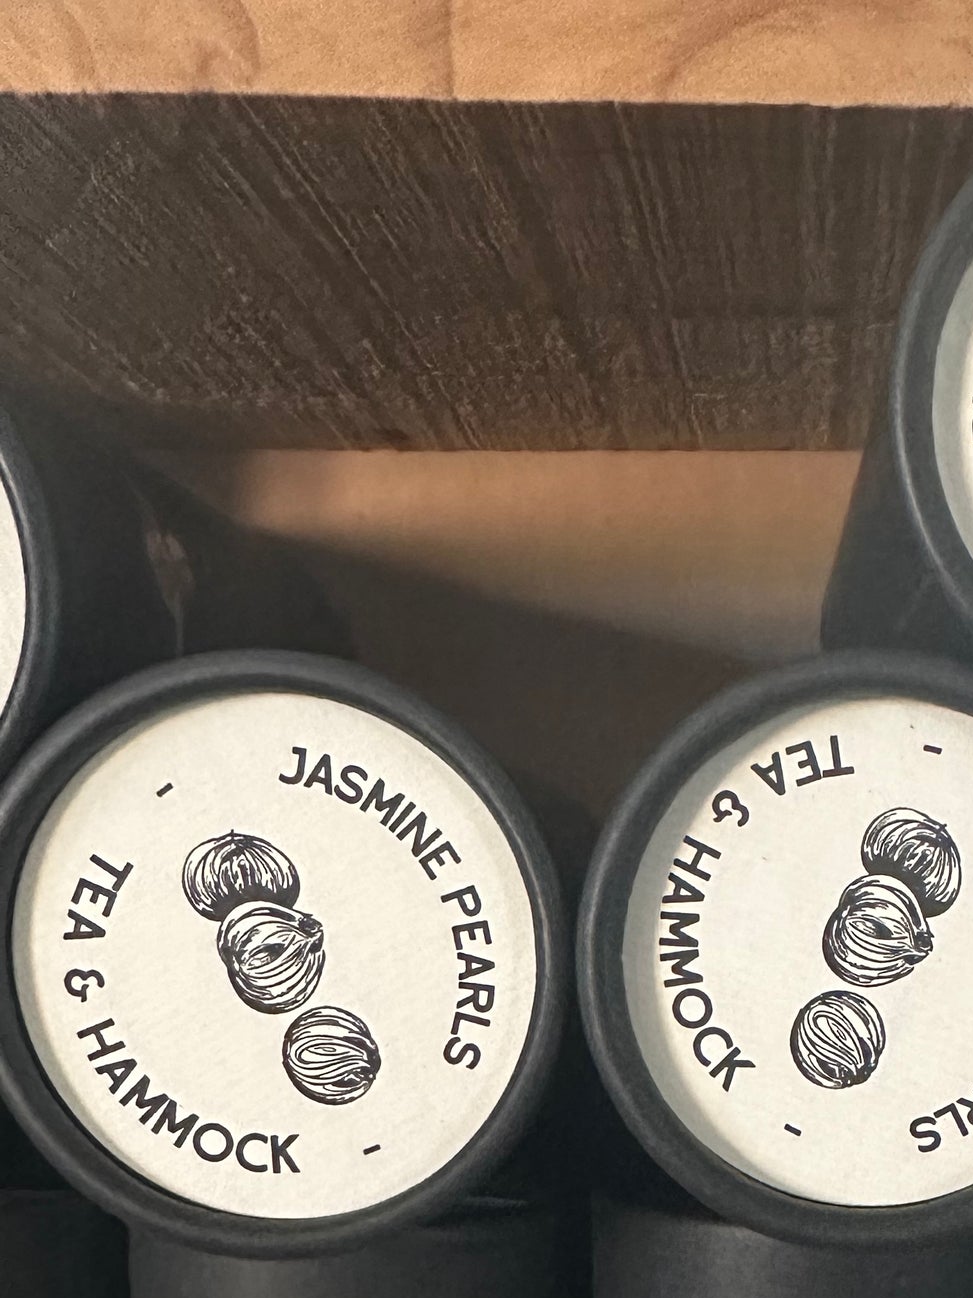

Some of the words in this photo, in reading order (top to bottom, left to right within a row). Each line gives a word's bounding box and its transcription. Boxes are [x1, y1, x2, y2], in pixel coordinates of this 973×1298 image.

[751, 735, 855, 796] TEA
[711, 790, 750, 828] &
[63, 854, 135, 940] TEA
[279, 746, 462, 881] JASMINE
[440, 884, 496, 1070] PEARLS
[64, 968, 105, 1003] &
[658, 835, 756, 1092] HAMMOCK
[76, 1018, 301, 1174] HAMMOCK
